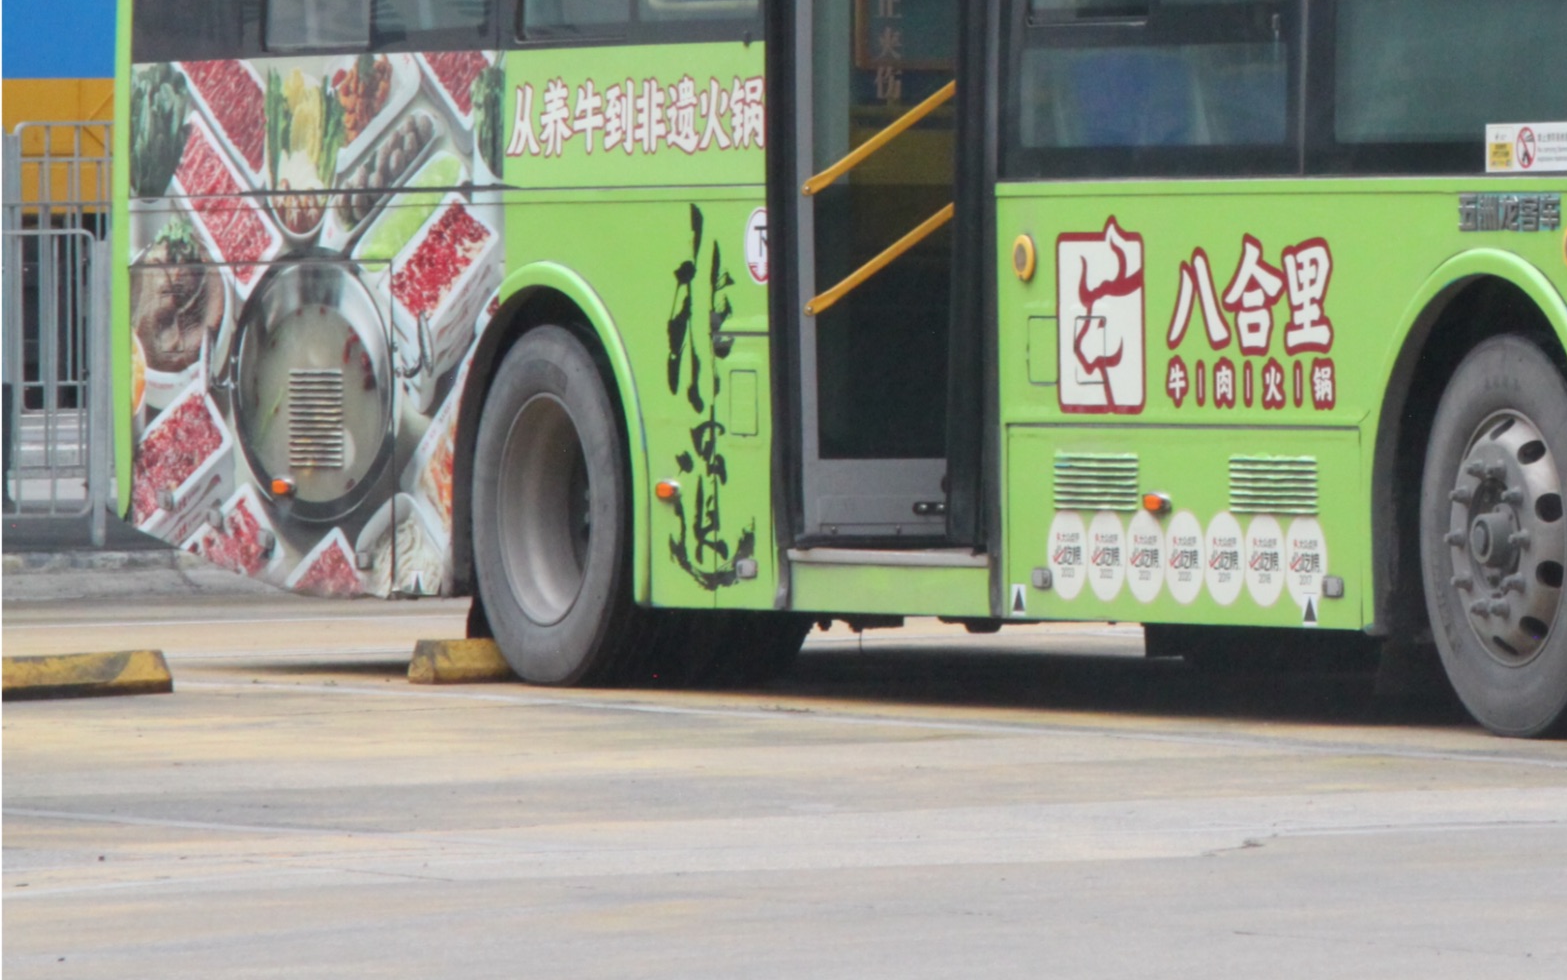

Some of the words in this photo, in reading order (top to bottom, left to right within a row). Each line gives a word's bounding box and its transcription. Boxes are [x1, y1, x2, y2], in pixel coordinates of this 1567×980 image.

[506, 73, 766, 157] 从养牛到非遗火锅
[1458, 192, 1562, 232] 五洲龙客车
[754, 226, 767, 257] 下
[1167, 233, 1335, 357] 八合里
[1217, 572, 1231, 582] 2019
